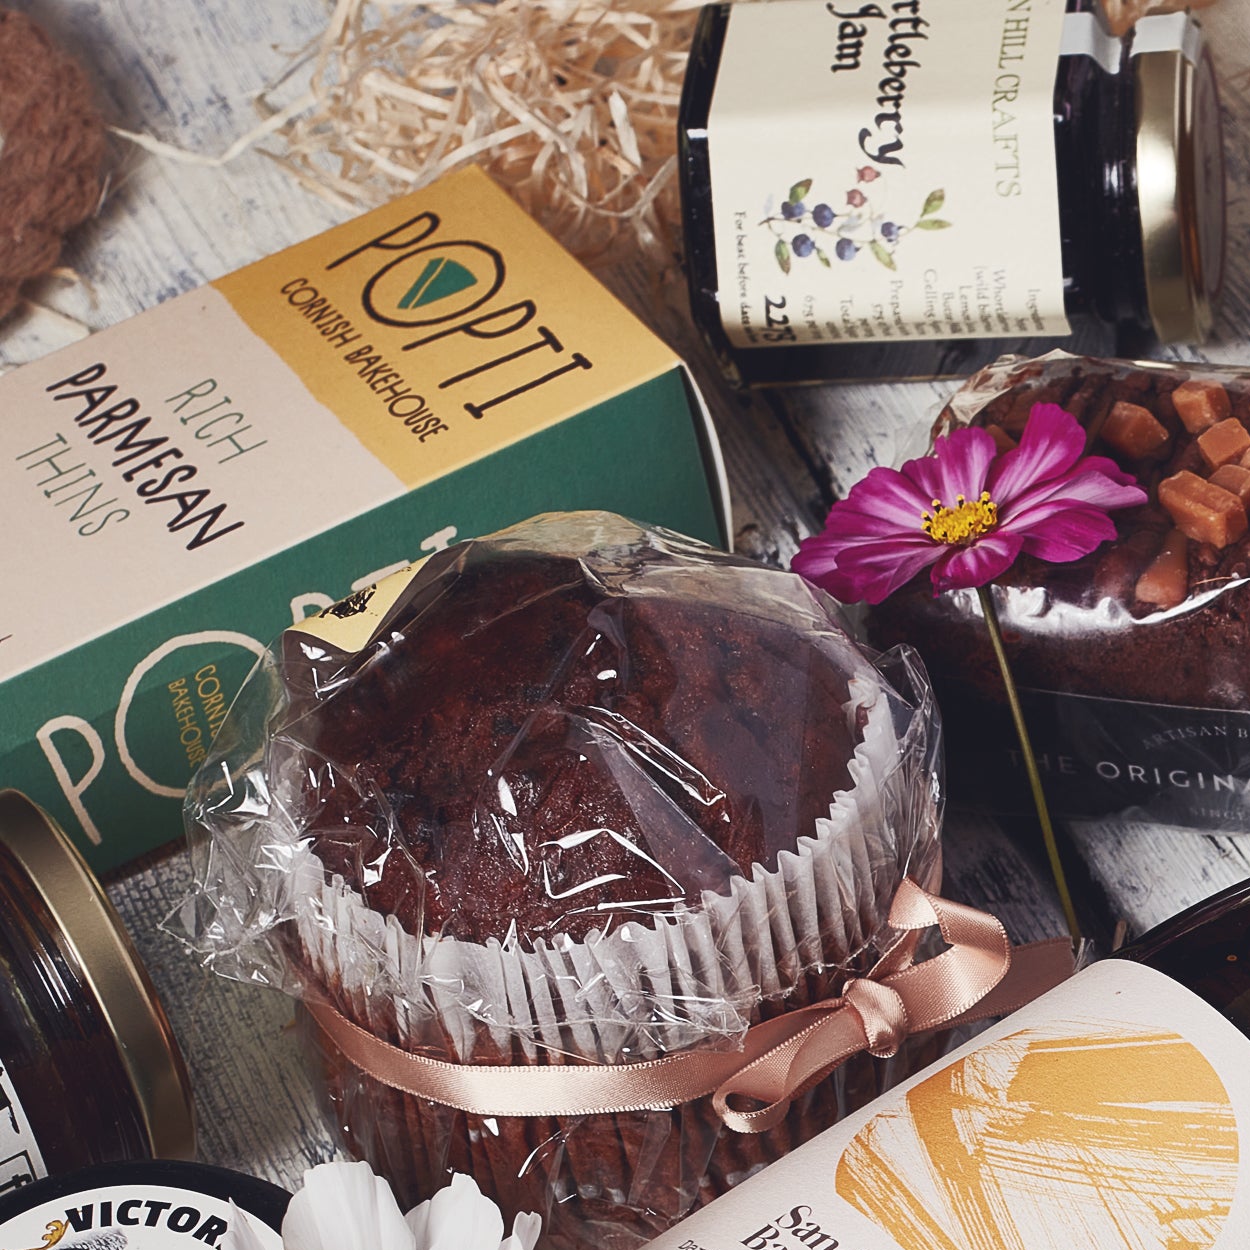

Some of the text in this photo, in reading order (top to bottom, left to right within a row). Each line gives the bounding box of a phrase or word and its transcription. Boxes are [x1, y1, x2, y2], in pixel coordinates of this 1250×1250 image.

[826, 2, 887, 73] Jam
[858, 0, 930, 168] rtleberry
[998, 17, 1030, 69] HILL
[992, 73, 1022, 198] CRAFTS
[279, 276, 450, 444] CORNISH BAKEHOUSE
[326, 211, 593, 420] POPTI
[46, 363, 245, 551] PARMESAN
[166, 378, 268, 464] RICH
[16, 433, 131, 538] THINS
[65, 1199, 229, 1250] VICTOR
